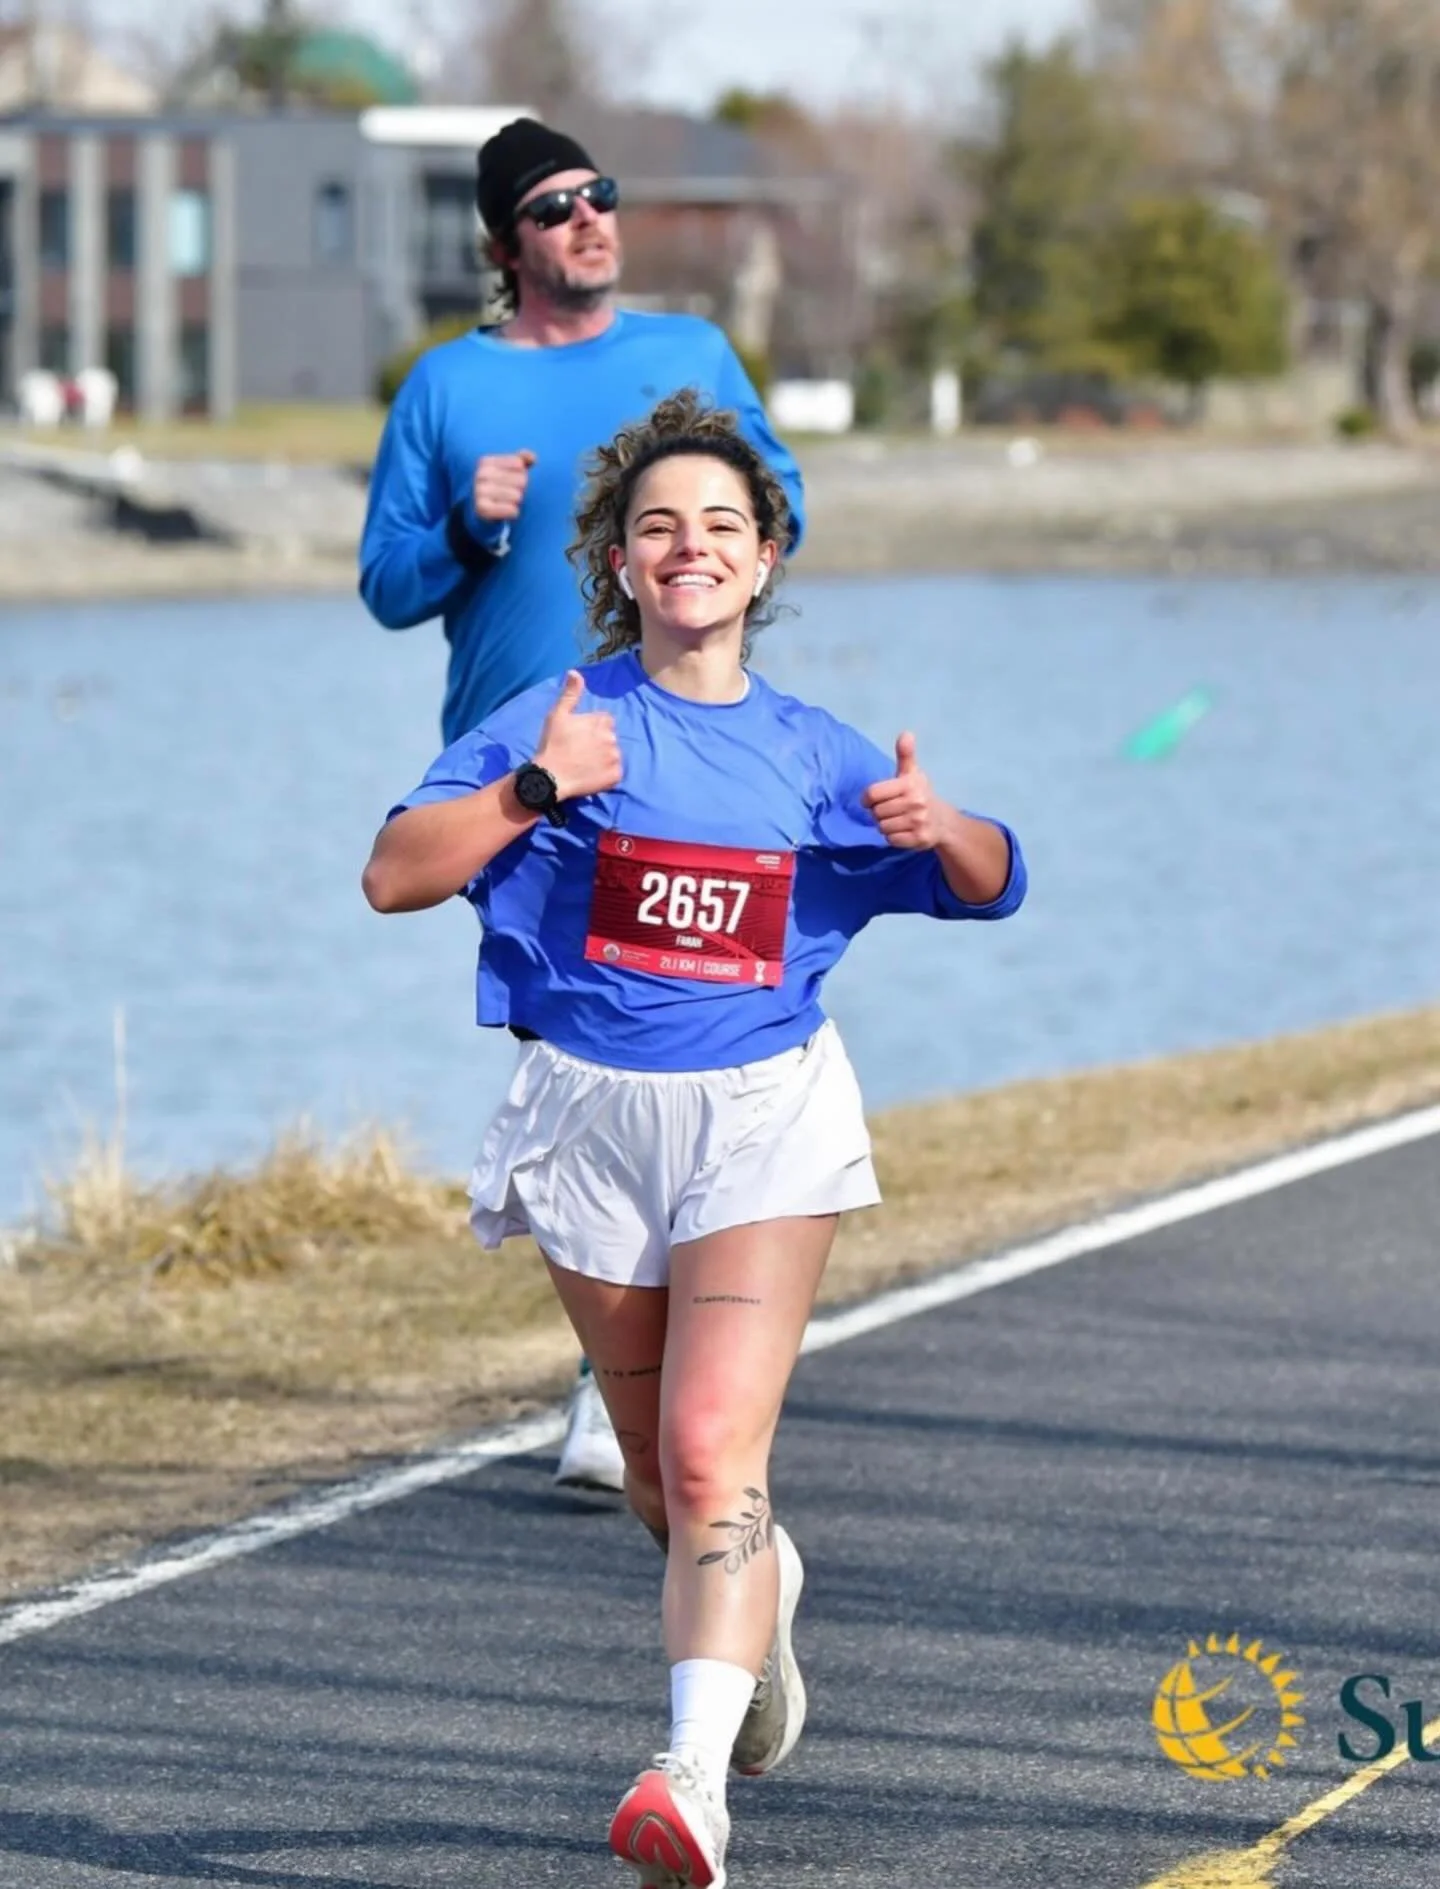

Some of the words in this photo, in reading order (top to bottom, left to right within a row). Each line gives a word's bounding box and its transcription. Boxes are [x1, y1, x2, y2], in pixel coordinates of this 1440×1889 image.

[621, 840, 629, 852] 2
[637, 871, 750, 934] 2657
[679, 958, 697, 972] KM
